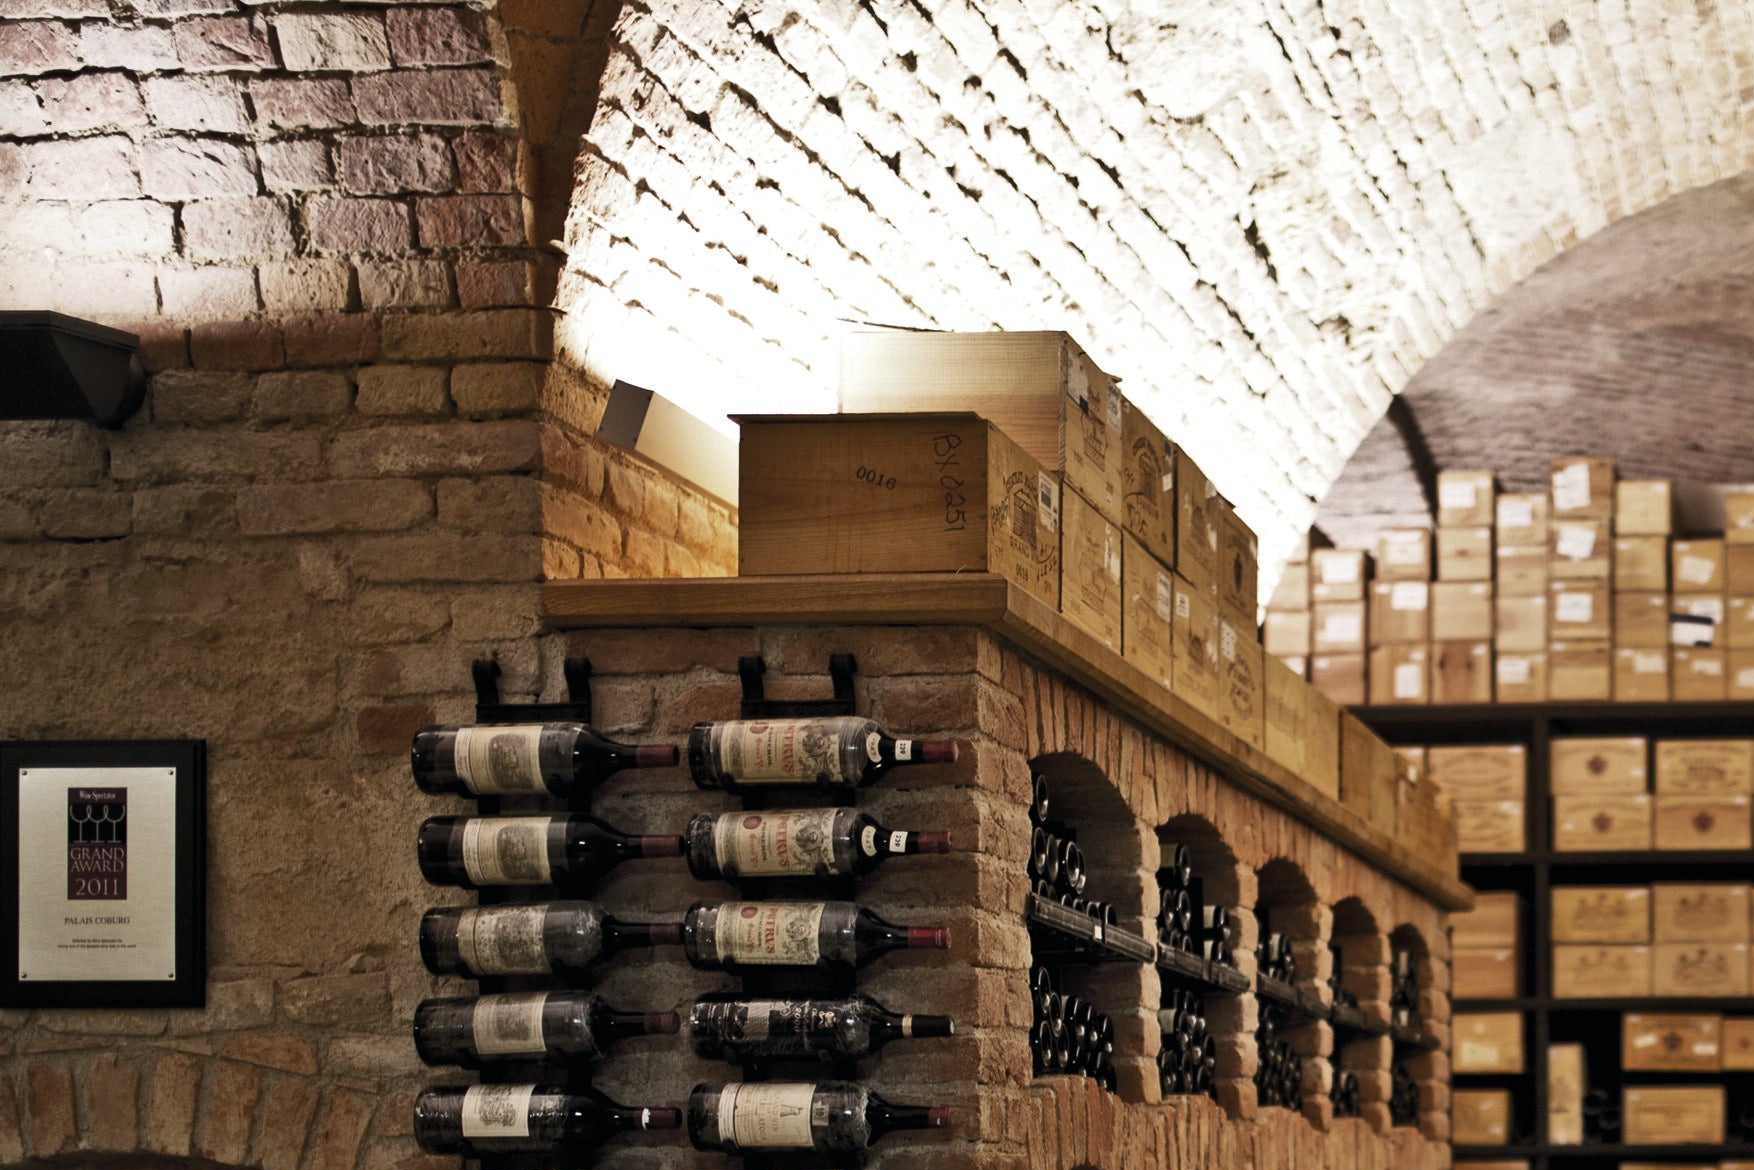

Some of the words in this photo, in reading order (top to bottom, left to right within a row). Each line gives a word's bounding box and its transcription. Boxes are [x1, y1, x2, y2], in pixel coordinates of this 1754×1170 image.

[856, 465, 897, 490] 0016
[79, 790, 92, 800] Wine
[92, 790, 116, 801] Spectator
[70, 847, 125, 861] GRAND
[70, 859, 124, 873] AWARD
[75, 878, 118, 896] 2011
[64, 916, 94, 925] PALAIS
[94, 916, 131, 925] COBURG
